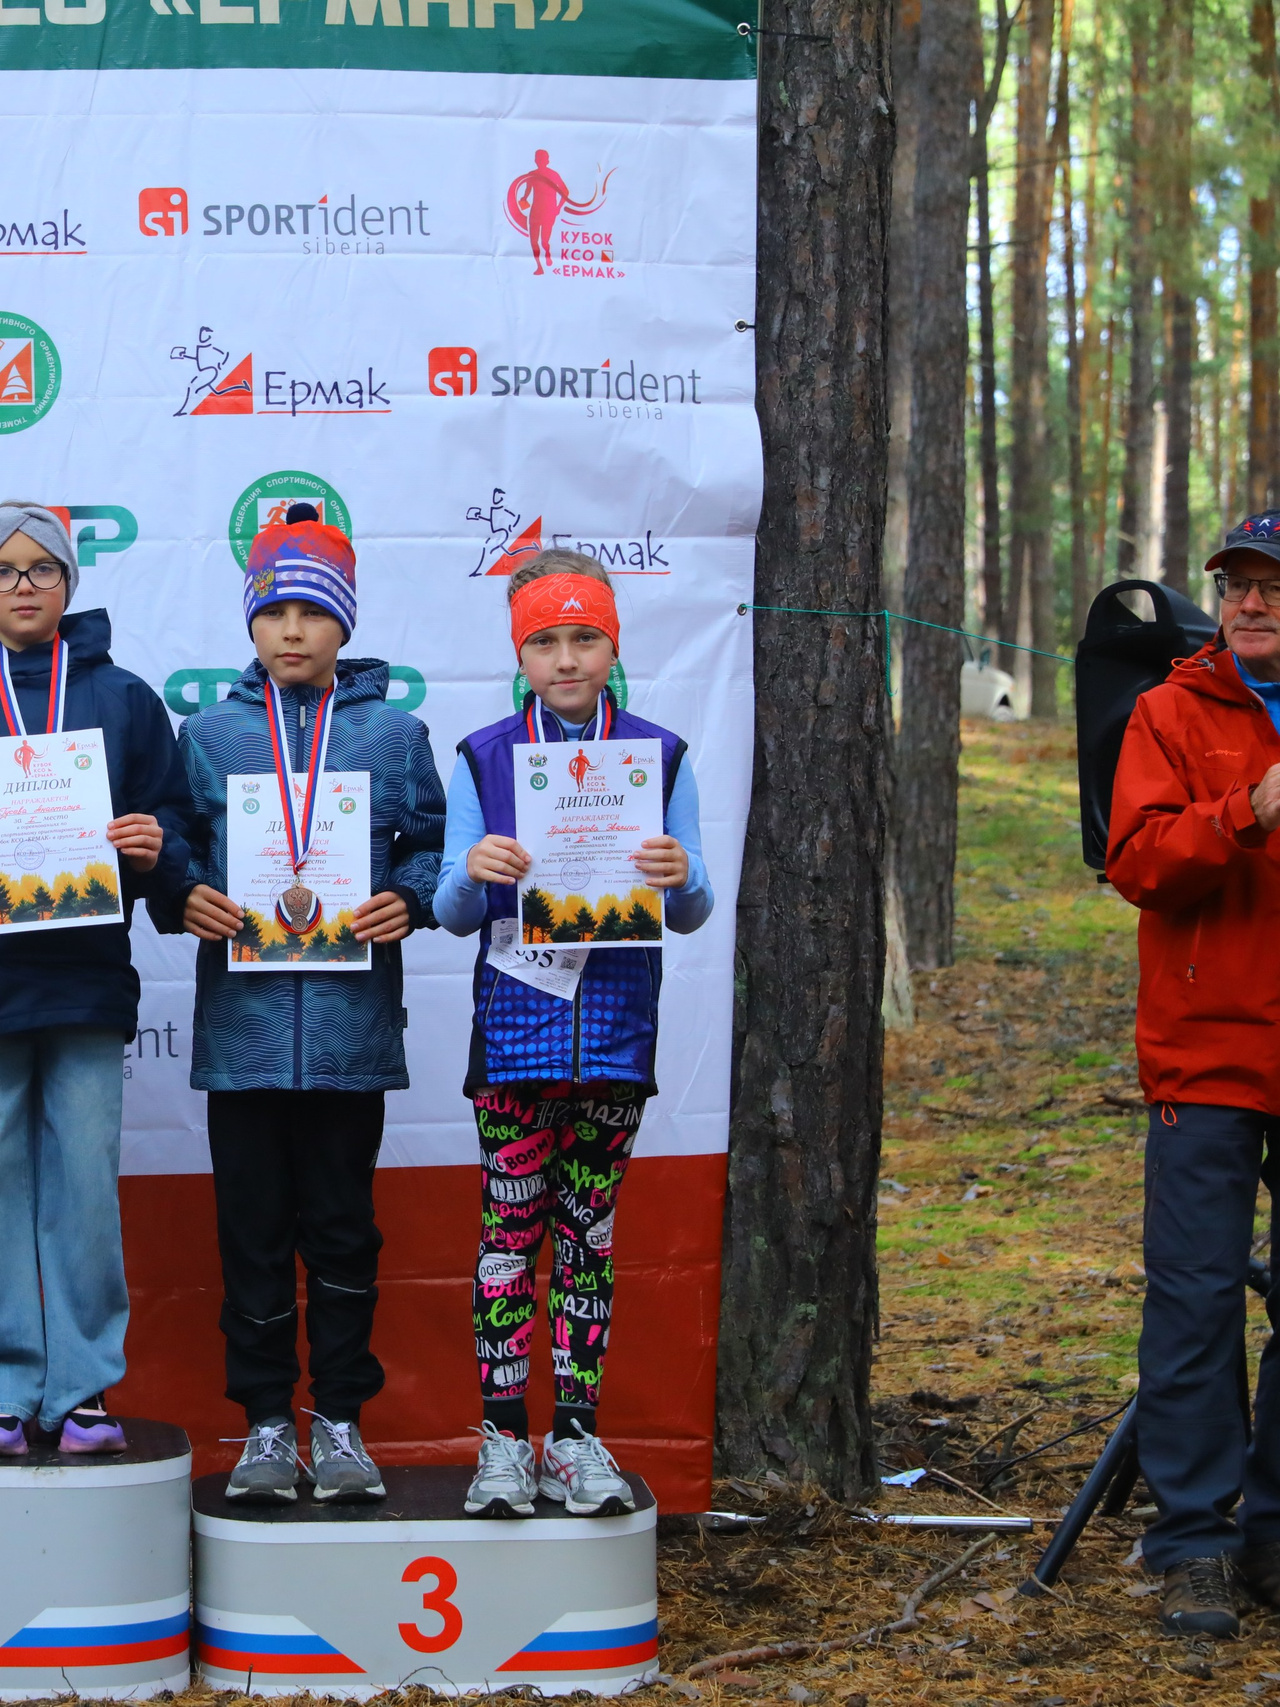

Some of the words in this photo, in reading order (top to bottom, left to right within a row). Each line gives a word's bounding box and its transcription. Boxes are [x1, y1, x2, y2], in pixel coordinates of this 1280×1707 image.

[302, 237, 385, 255] siberia
[560, 231, 613, 245] КУБОК
[560, 249, 594, 261] КСО
[552, 265, 625, 279] «ЕРМАК»
[32, 340, 56, 415] ОРИЕНТИРОВАНИЯ
[265, 367, 390, 416] Ермак
[587, 401, 663, 420] siberia
[235, 487, 262, 534] ФЕДЕРАЦИЯ
[266, 476, 327, 495] СПОРТИВНОГО
[3, 778, 72, 795] ДИПЛОМ
[11, 795, 69, 806] НАГРАЖДАЕТСЯ
[555, 794, 624, 810] ДИПЛОМ
[561, 814, 620, 823] НАГРАЖДАЕТСЯ
[479, 1109, 524, 1140] love
[485, 1297, 534, 1327] love
[399, 1556, 463, 1654] 3
